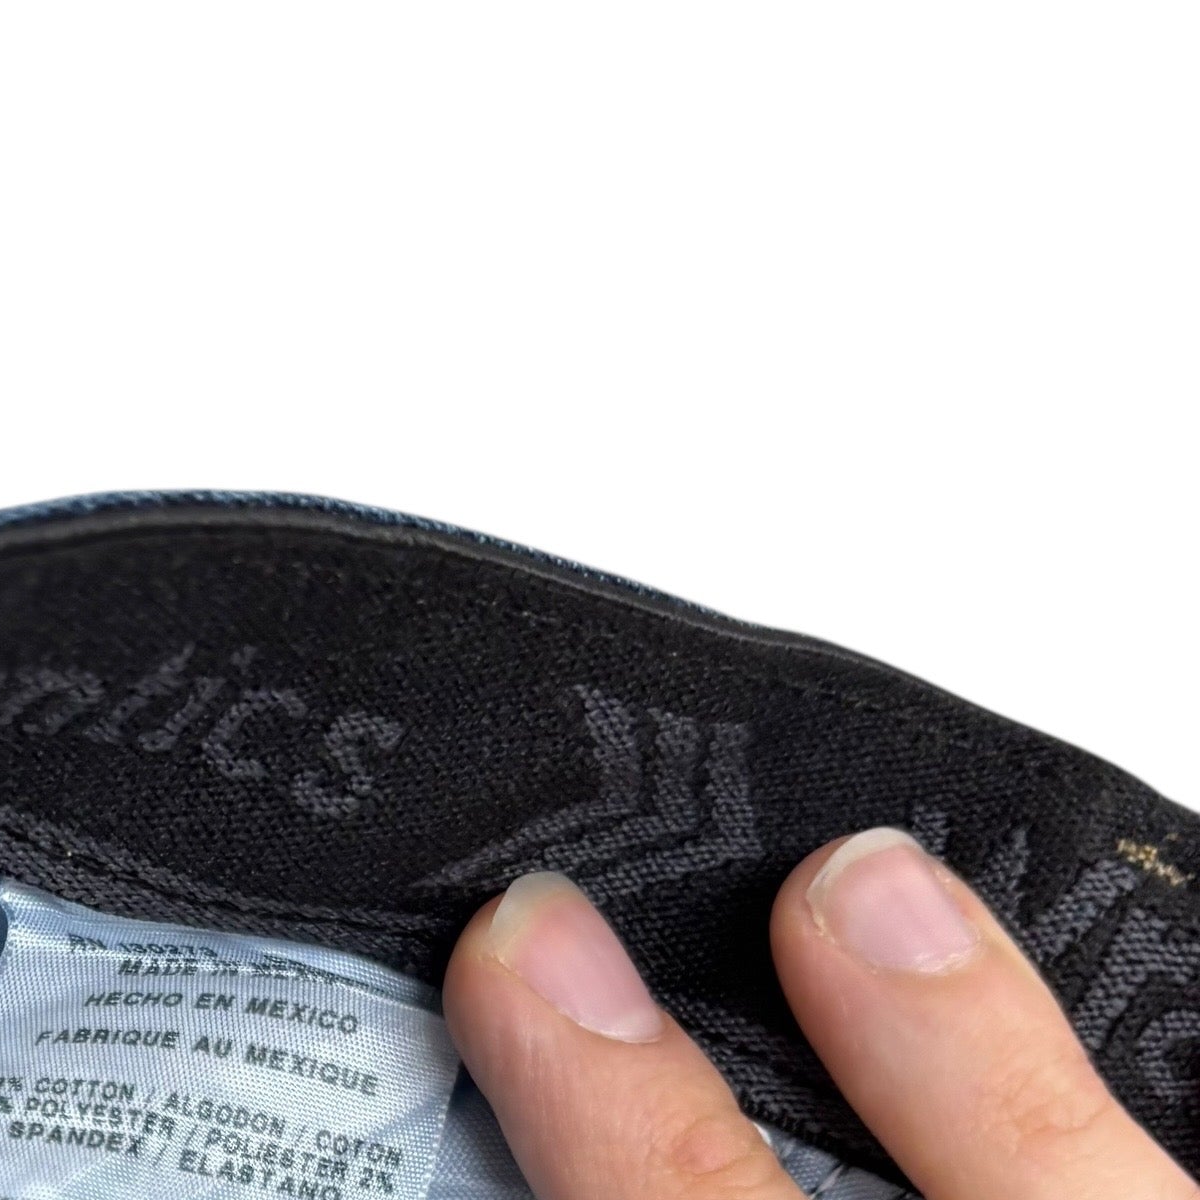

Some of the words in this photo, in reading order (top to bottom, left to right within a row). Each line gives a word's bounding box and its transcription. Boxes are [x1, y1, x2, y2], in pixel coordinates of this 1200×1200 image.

[84, 991, 182, 1008] HECHO
[195, 992, 234, 1011] EN
[244, 997, 358, 1034] MEXICO
[35, 1030, 179, 1049] FABRIQUE
[193, 1034, 233, 1059] AU
[245, 1044, 378, 1096] MEXIQUE
[8, 1120, 144, 1157] SPANDEX
[25, 1097, 175, 1138] POLYESTER
[205, 1128, 347, 1181] POLIESTER
[35, 1077, 135, 1101] COTTON
[163, 1092, 286, 1138] ALGODON
[316, 1129, 401, 1168] COTON
